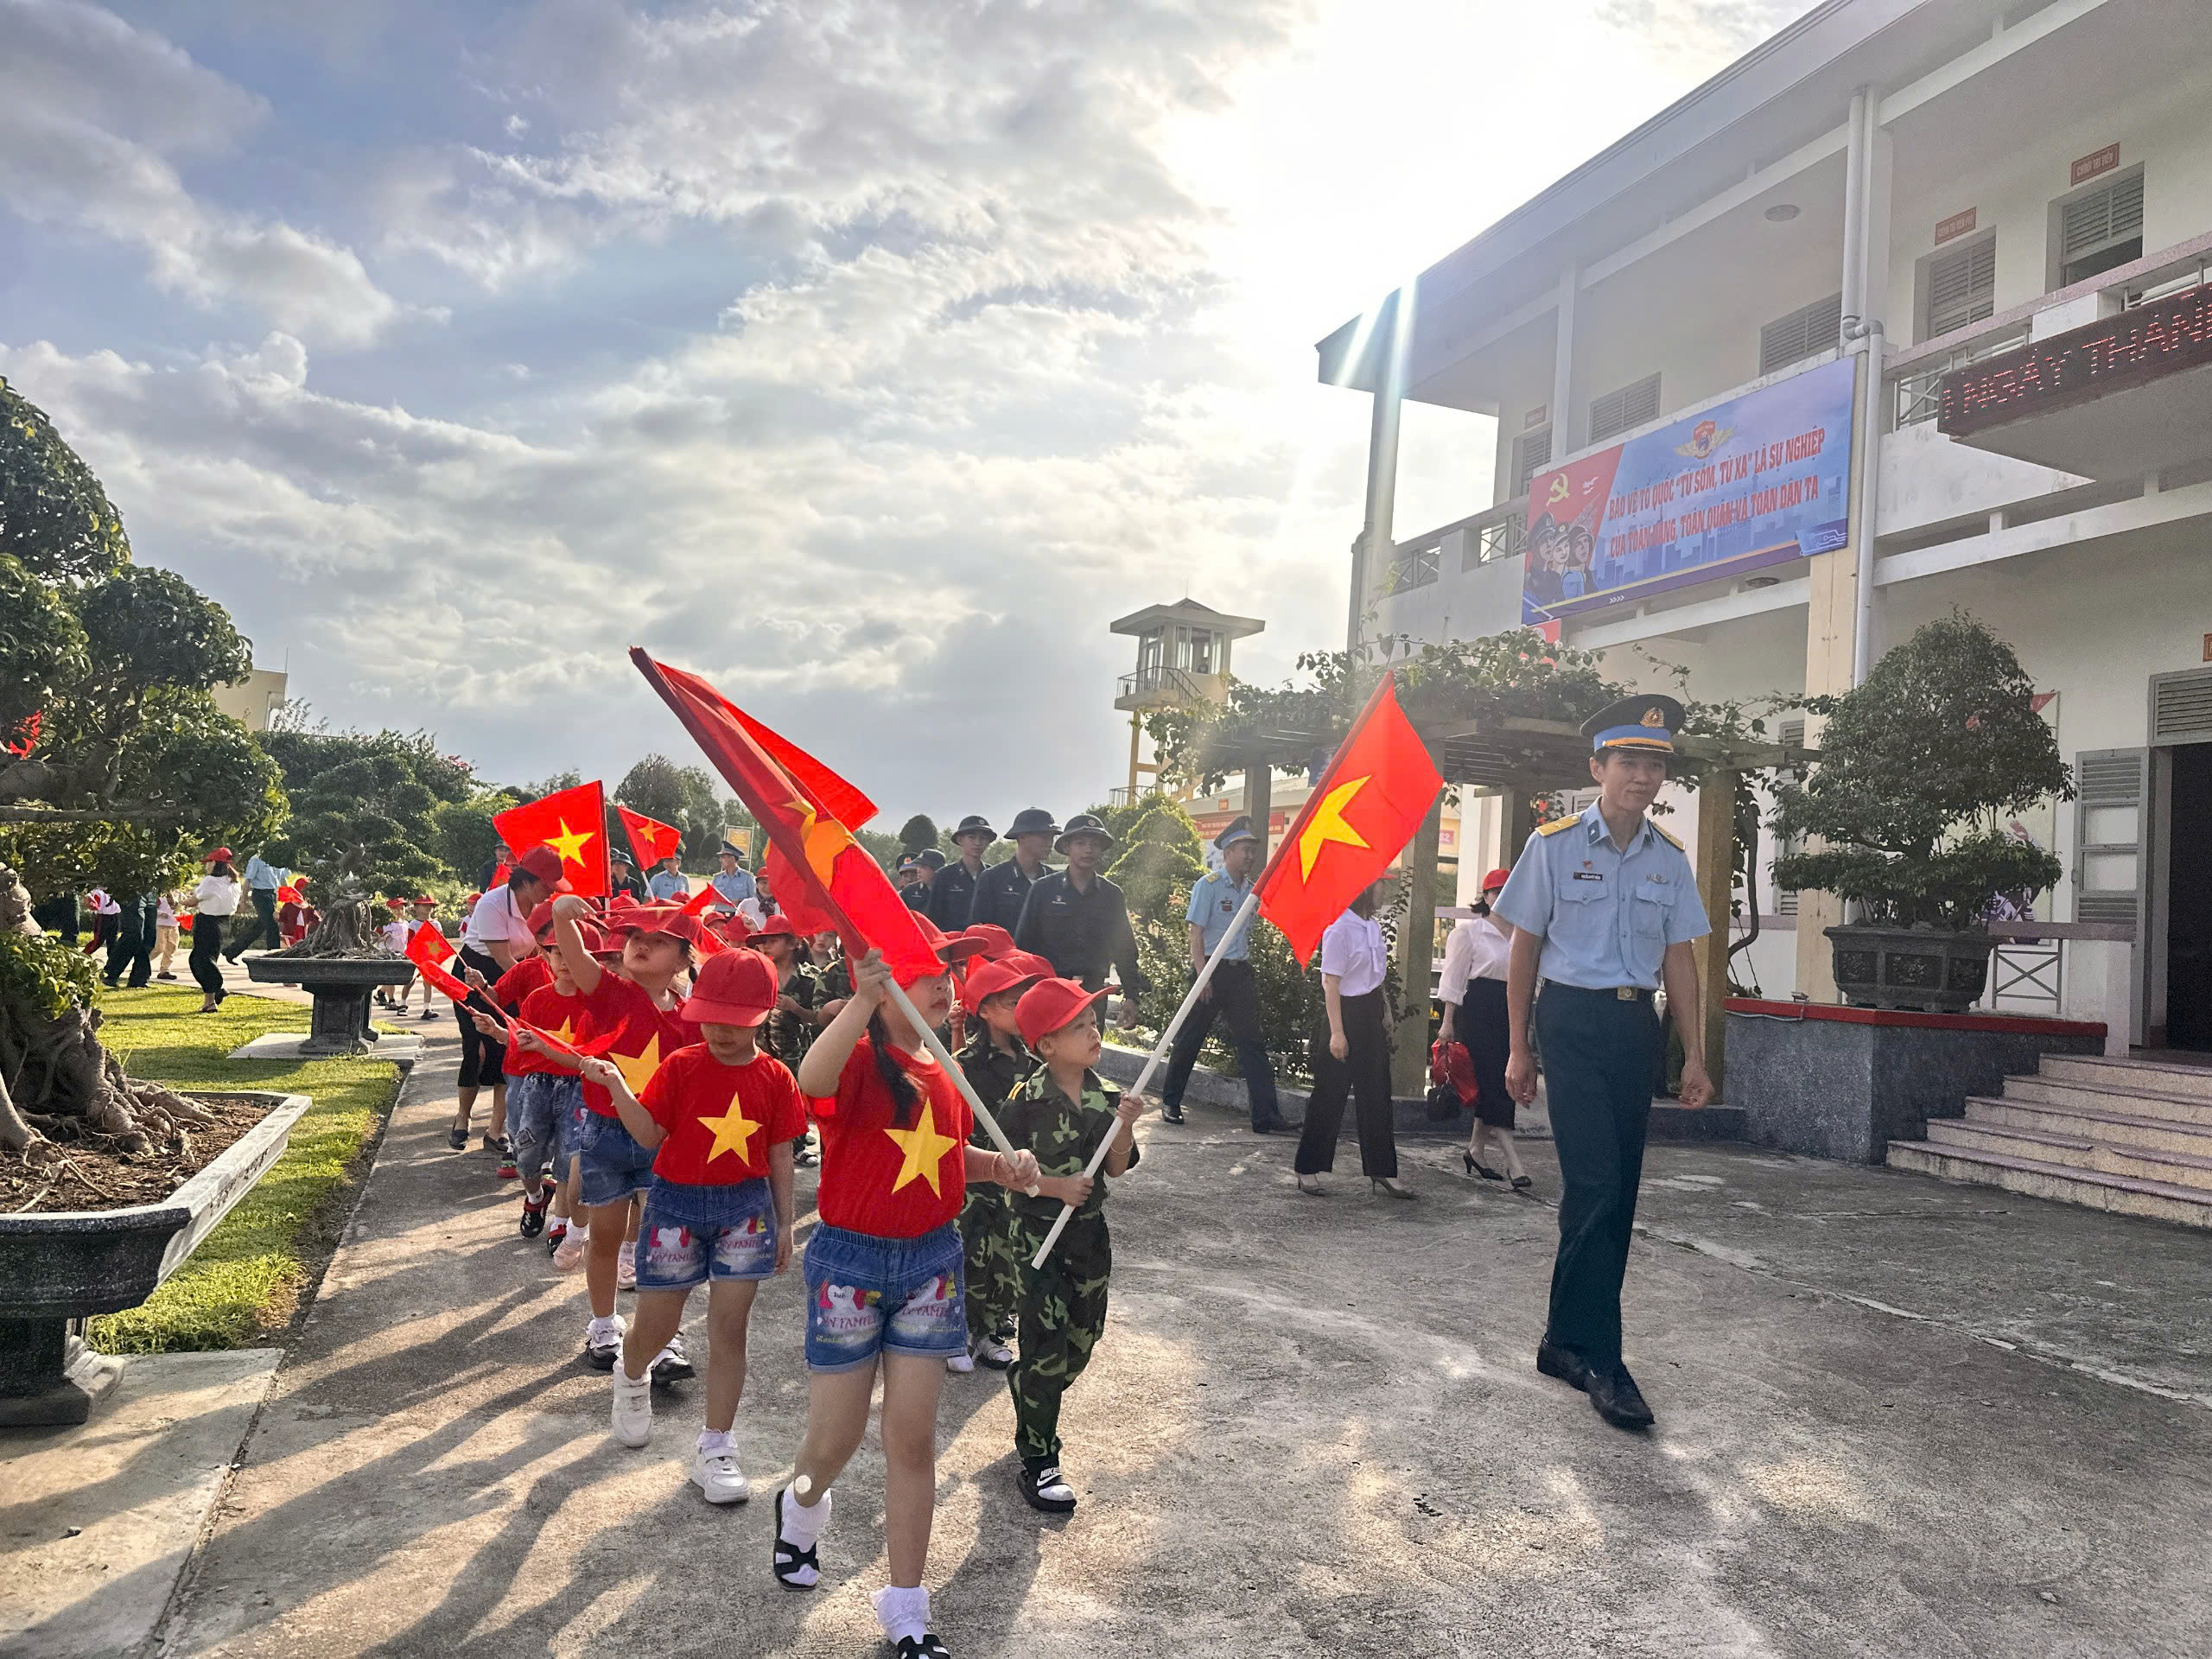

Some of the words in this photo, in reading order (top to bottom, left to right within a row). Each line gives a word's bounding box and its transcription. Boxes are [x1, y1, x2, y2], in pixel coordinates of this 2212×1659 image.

[1627, 486, 1638, 518] VỆ
[1652, 471, 1674, 510] QUỐC
[1720, 454, 1733, 485] TỪ
[1754, 442, 1766, 474] LÀ
[1769, 442, 1784, 472] SỰ
[1785, 424, 1825, 464] NGHIỆP
[1611, 528, 1625, 558] CỦA
[1681, 507, 1704, 538] TOÀN
[1751, 485, 1777, 518] TOÀN
[1780, 477, 1802, 510] DÂN
[1804, 474, 1819, 502] TA
[1040, 1466, 1058, 1479] NIKE
